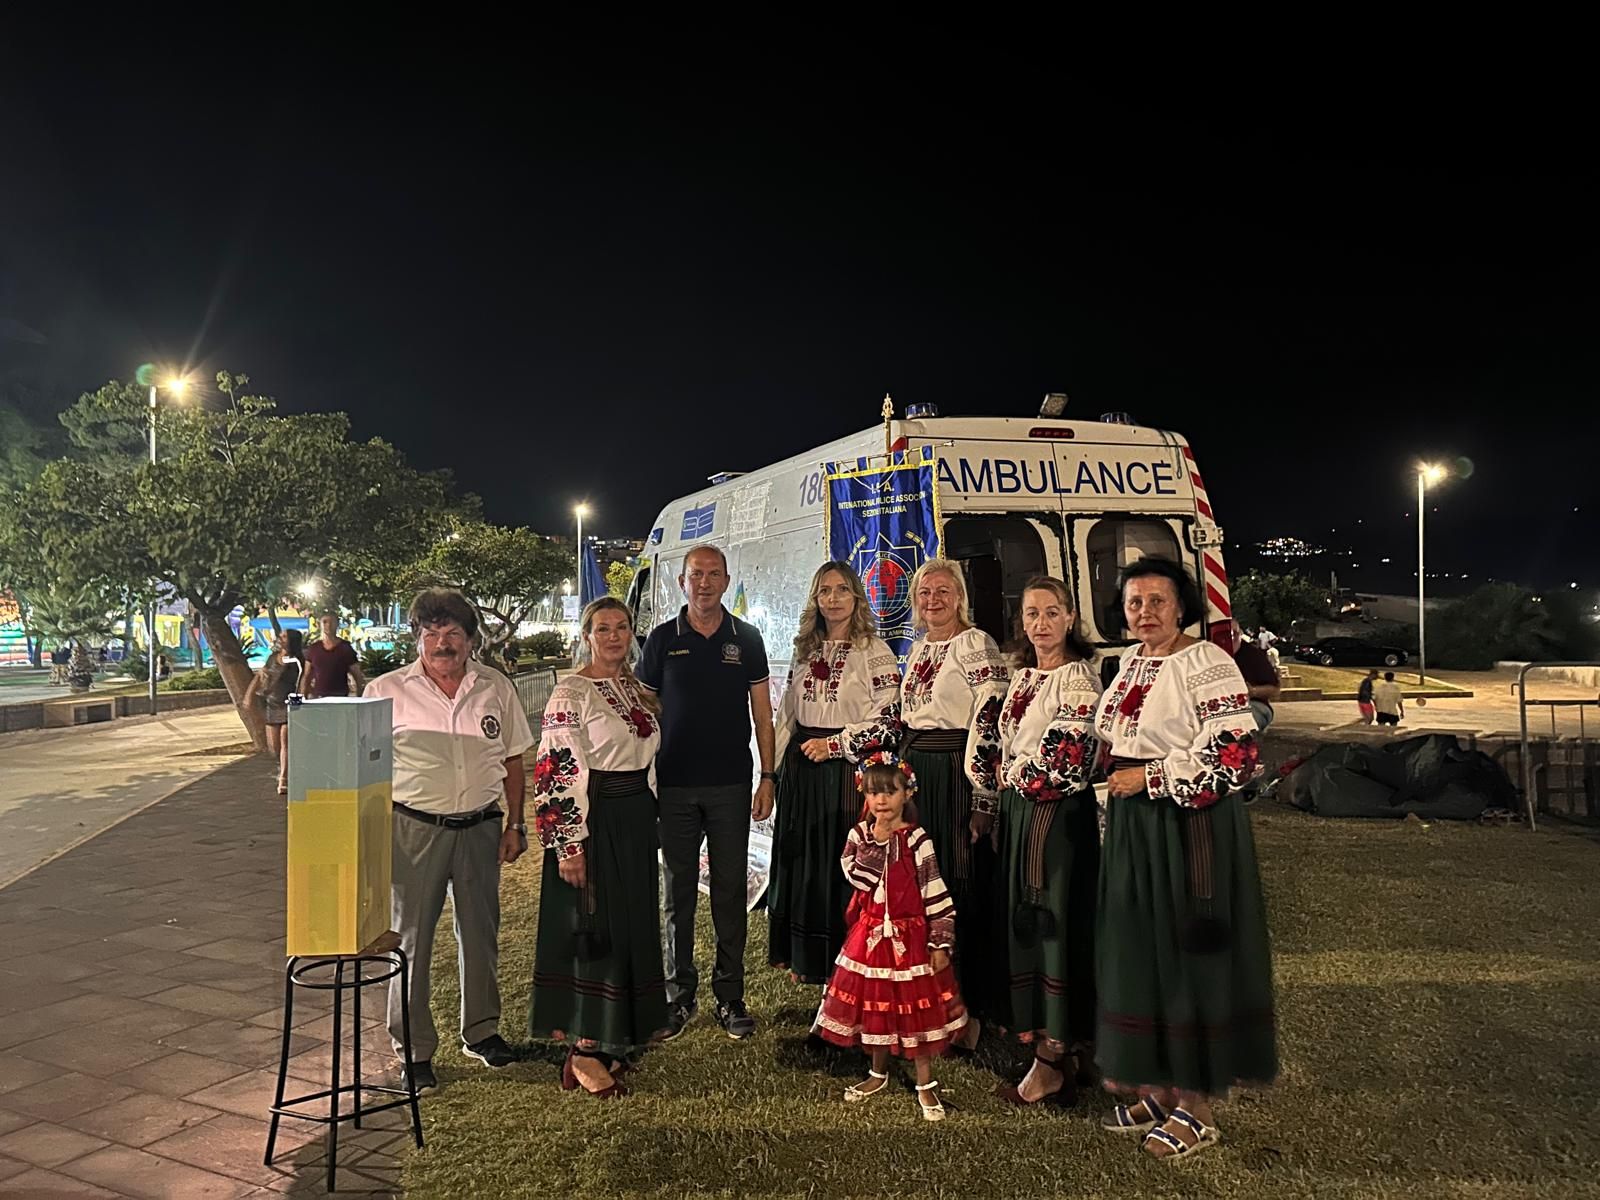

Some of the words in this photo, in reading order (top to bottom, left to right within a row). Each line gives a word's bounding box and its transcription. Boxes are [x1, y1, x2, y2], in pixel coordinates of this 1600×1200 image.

[937, 457, 1177, 495] AMBULANCE
[838, 499, 876, 510] INTENATIONAL
[876, 496, 895, 504] PLICE
[880, 505, 908, 514] ITALIANA
